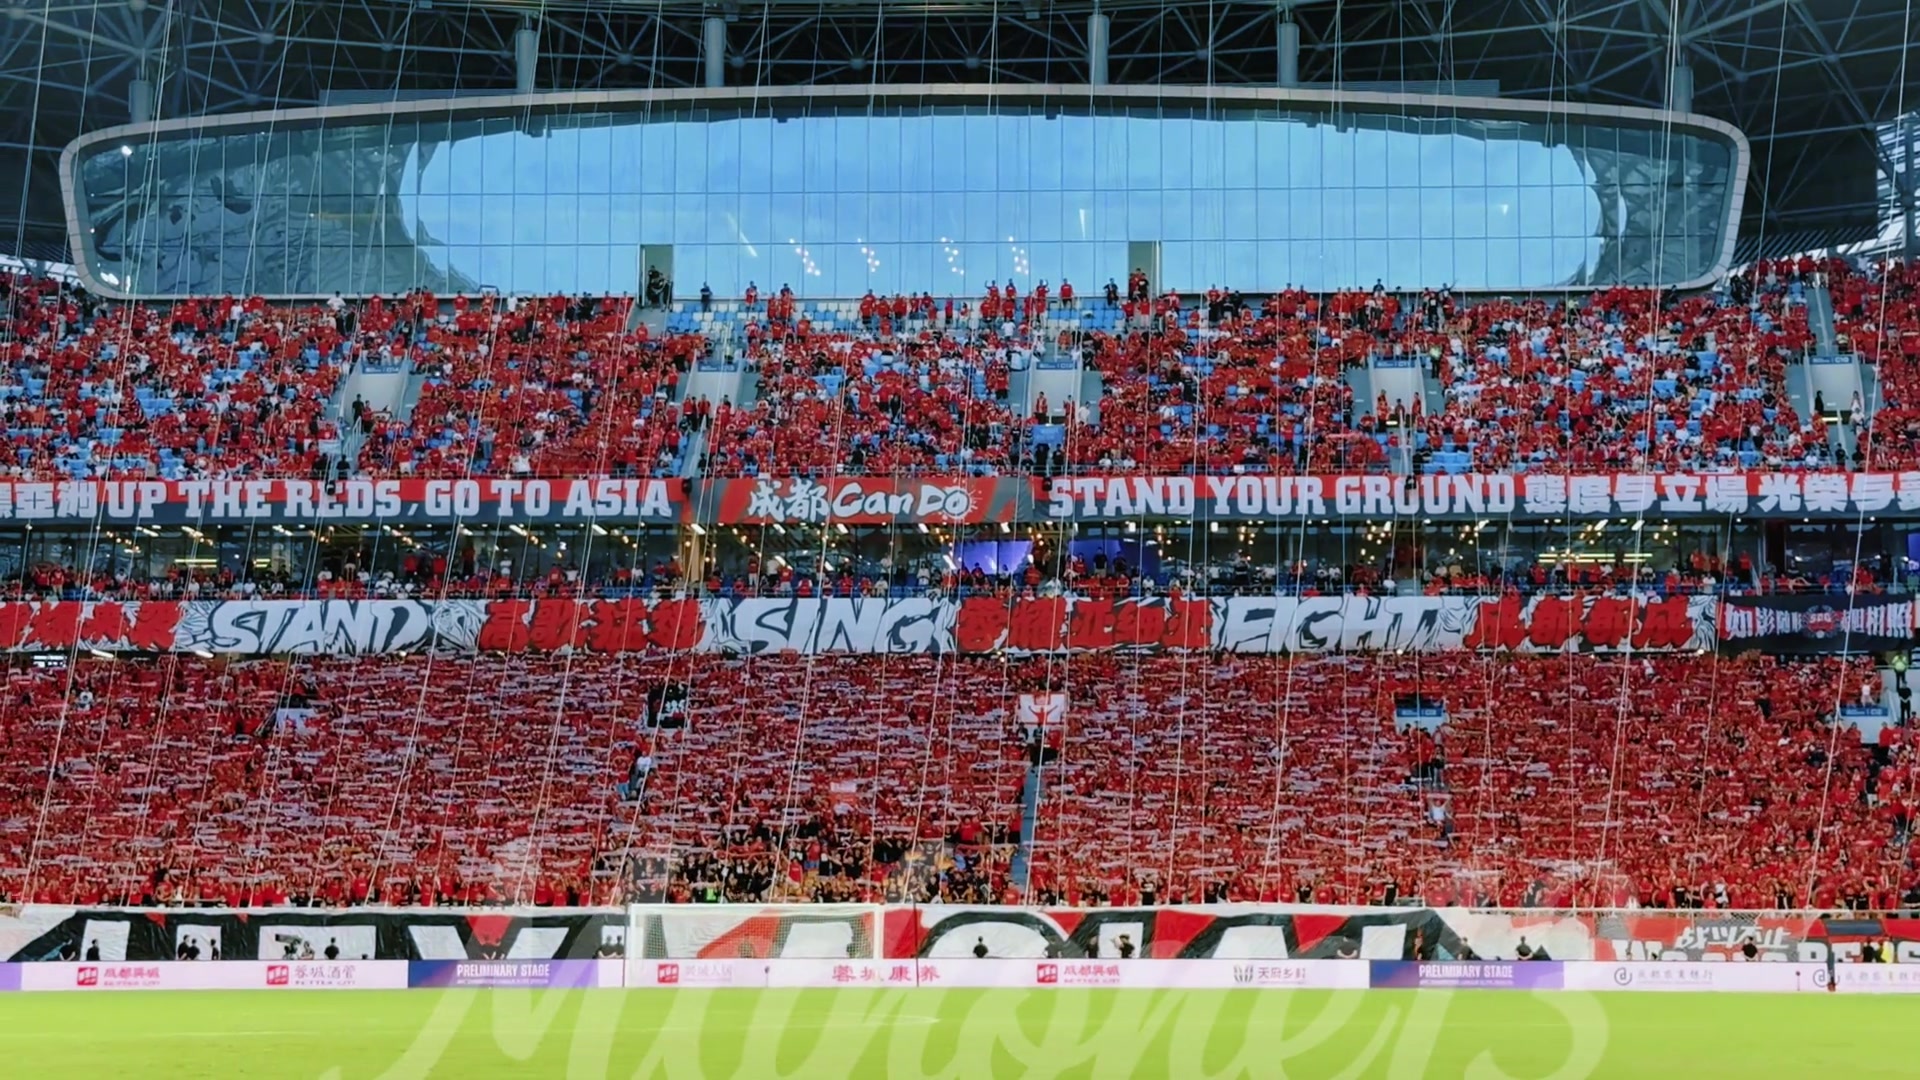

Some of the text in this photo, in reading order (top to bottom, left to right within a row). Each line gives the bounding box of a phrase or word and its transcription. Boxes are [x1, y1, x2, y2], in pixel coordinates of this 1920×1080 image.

[107, 481, 167, 517] UP
[178, 480, 273, 517] THE
[424, 479, 486, 517] GO
[491, 479, 557, 517] TO
[562, 479, 672, 517] ASIA
[748, 480, 830, 520] 成都
[832, 483, 913, 519] Can
[1049, 474, 1515, 516] STAND YOUR GROUND
[209, 600, 428, 652] STAND
[732, 599, 938, 653] SING
[1225, 598, 1445, 652] FIGHT
[457, 964, 550, 977] PRELIMINARY STAGE
[832, 964, 940, 982] 蓉城康养
[1419, 965, 1513, 978] PRELIMINARY STAGE
